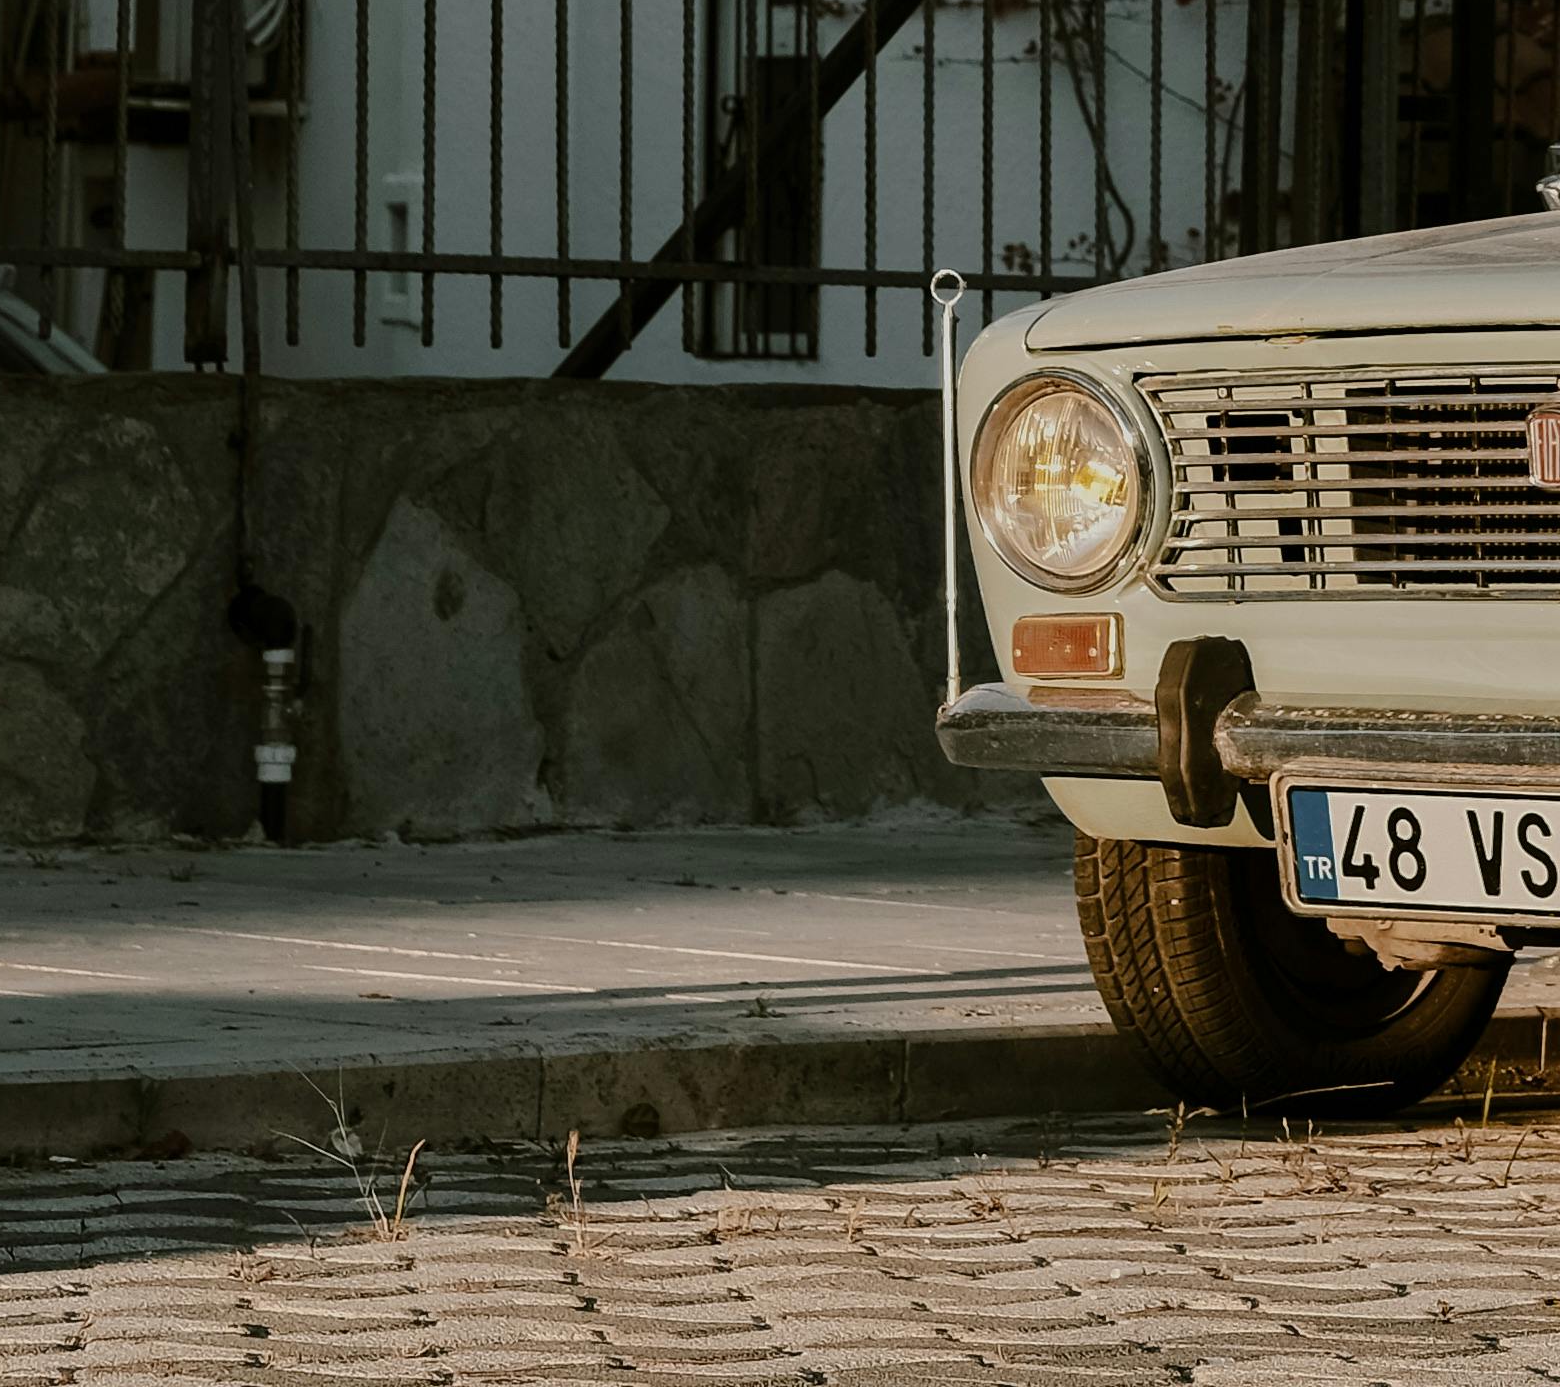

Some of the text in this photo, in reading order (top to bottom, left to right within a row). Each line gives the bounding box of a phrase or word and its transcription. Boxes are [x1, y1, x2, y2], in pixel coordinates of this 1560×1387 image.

[1303, 854, 1334, 881] TR
[1341, 805, 1428, 893] 48
[1466, 810, 1558, 900] VS
